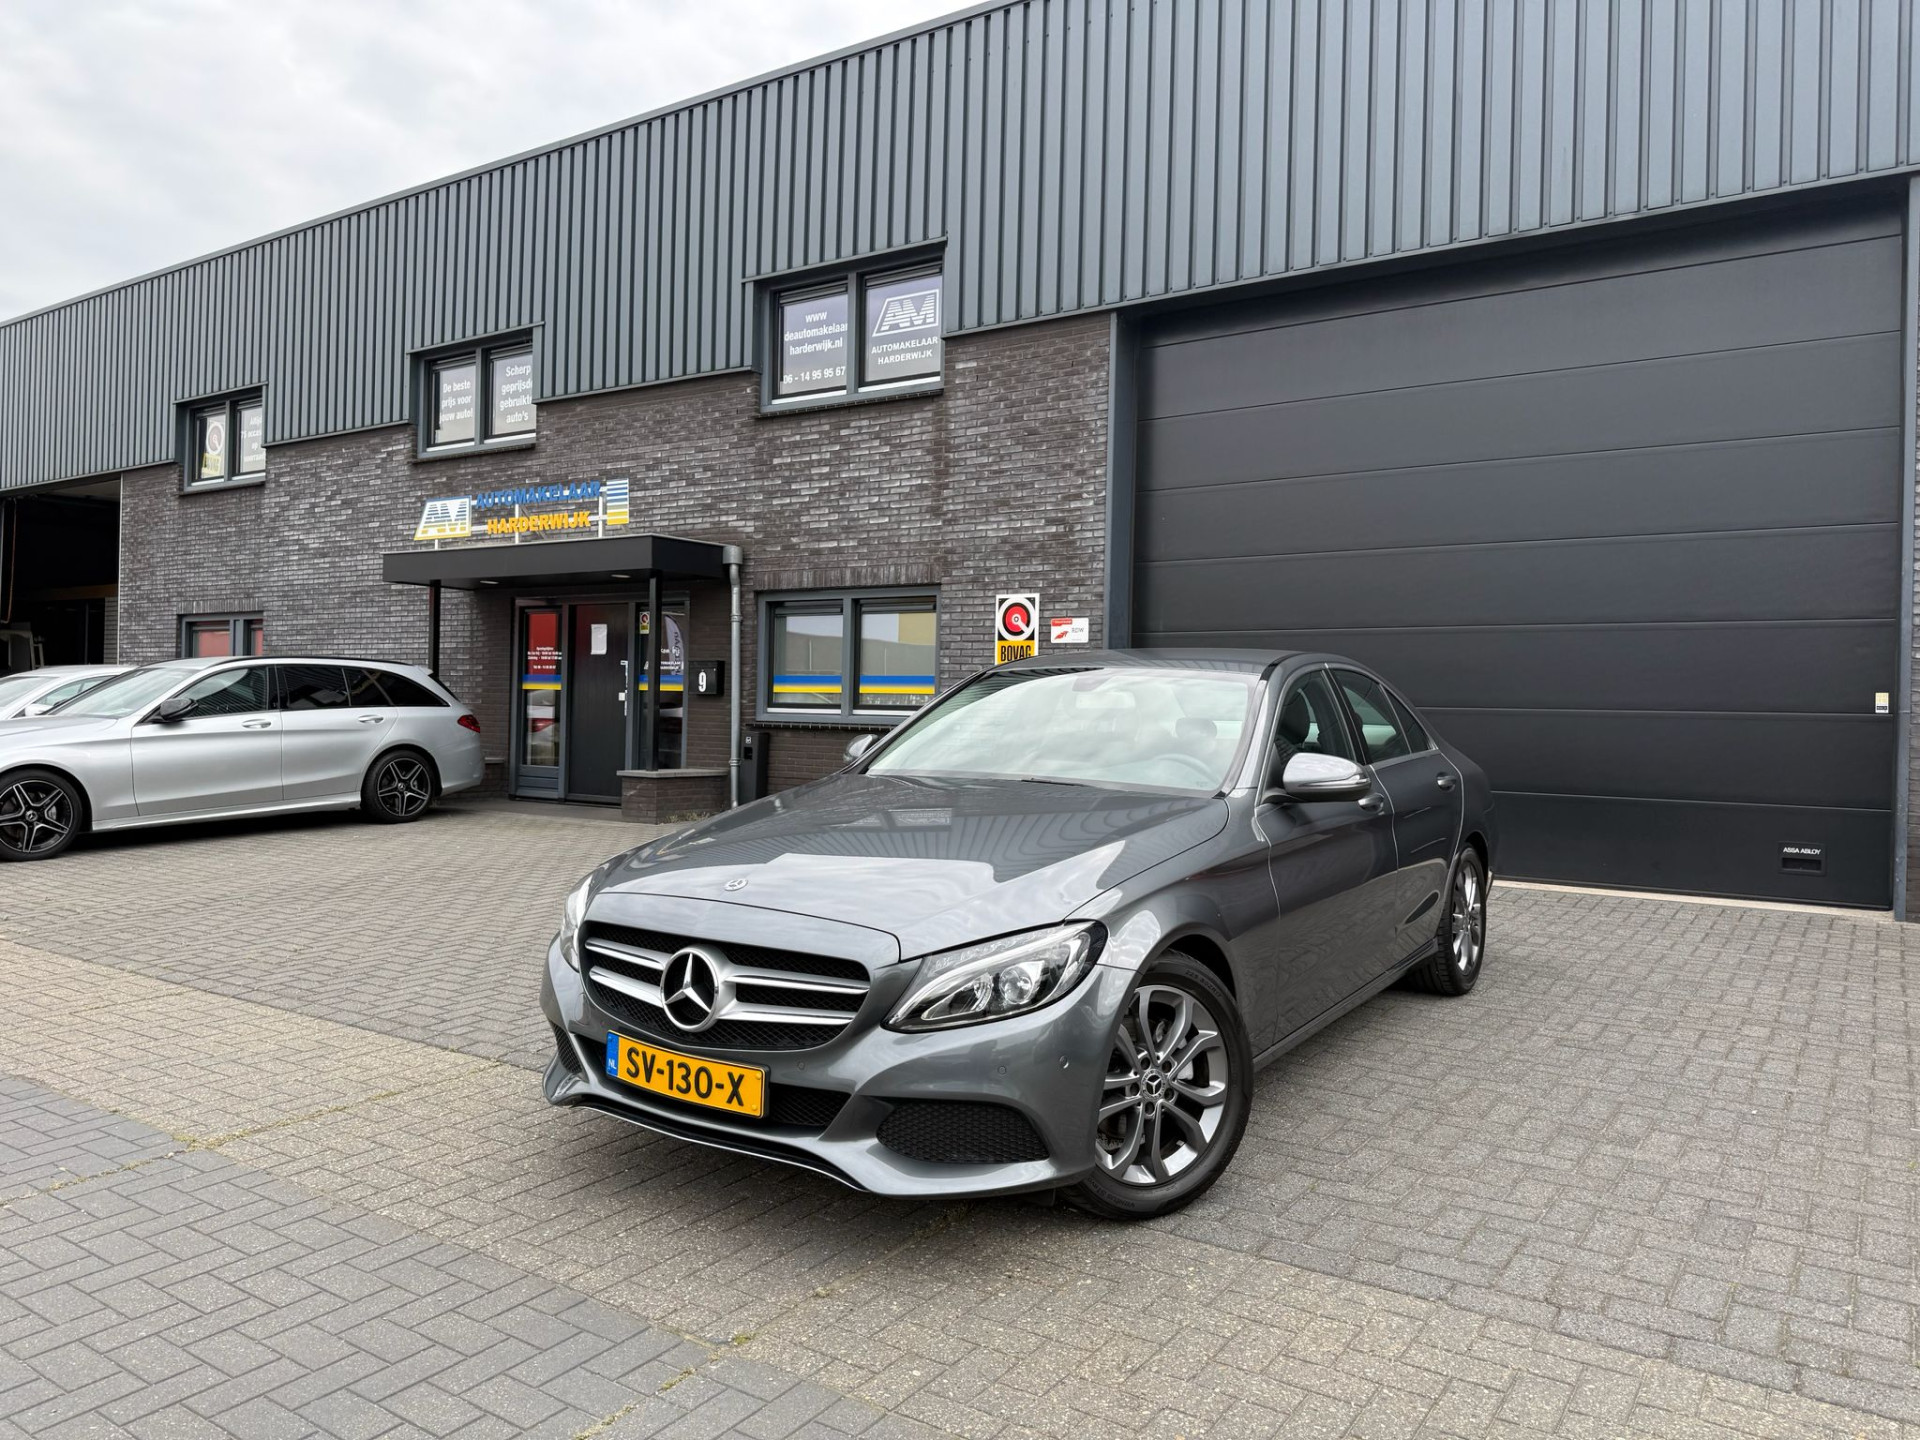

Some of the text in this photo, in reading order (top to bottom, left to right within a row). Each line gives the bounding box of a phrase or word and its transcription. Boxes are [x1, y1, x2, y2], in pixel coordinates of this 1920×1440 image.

[805, 312, 827, 322] www
[784, 323, 848, 341] deautomakelaar
[790, 337, 843, 355] harderwijk.nl
[871, 336, 938, 354] AUTOMAKELAAR
[878, 349, 932, 365] HARDERWIJK
[505, 364, 531, 377] Scherp
[800, 371, 810, 381] 14
[812, 369, 822, 380] 95
[823, 367, 834, 378] 95
[835, 366, 846, 376] 67
[443, 380, 471, 393] De beste
[441, 395, 472, 410] prijs voor
[506, 410, 529, 424] auto's
[475, 480, 601, 509] AUTOMAKELAAR
[487, 510, 591, 535] HARDERWIJK
[1000, 645, 1032, 662] BOVAG
[698, 671, 707, 692] 9
[1783, 846, 1799, 854] ASSA
[608, 1058, 617, 1070] NL
[626, 1047, 745, 1107] SV-130-X
